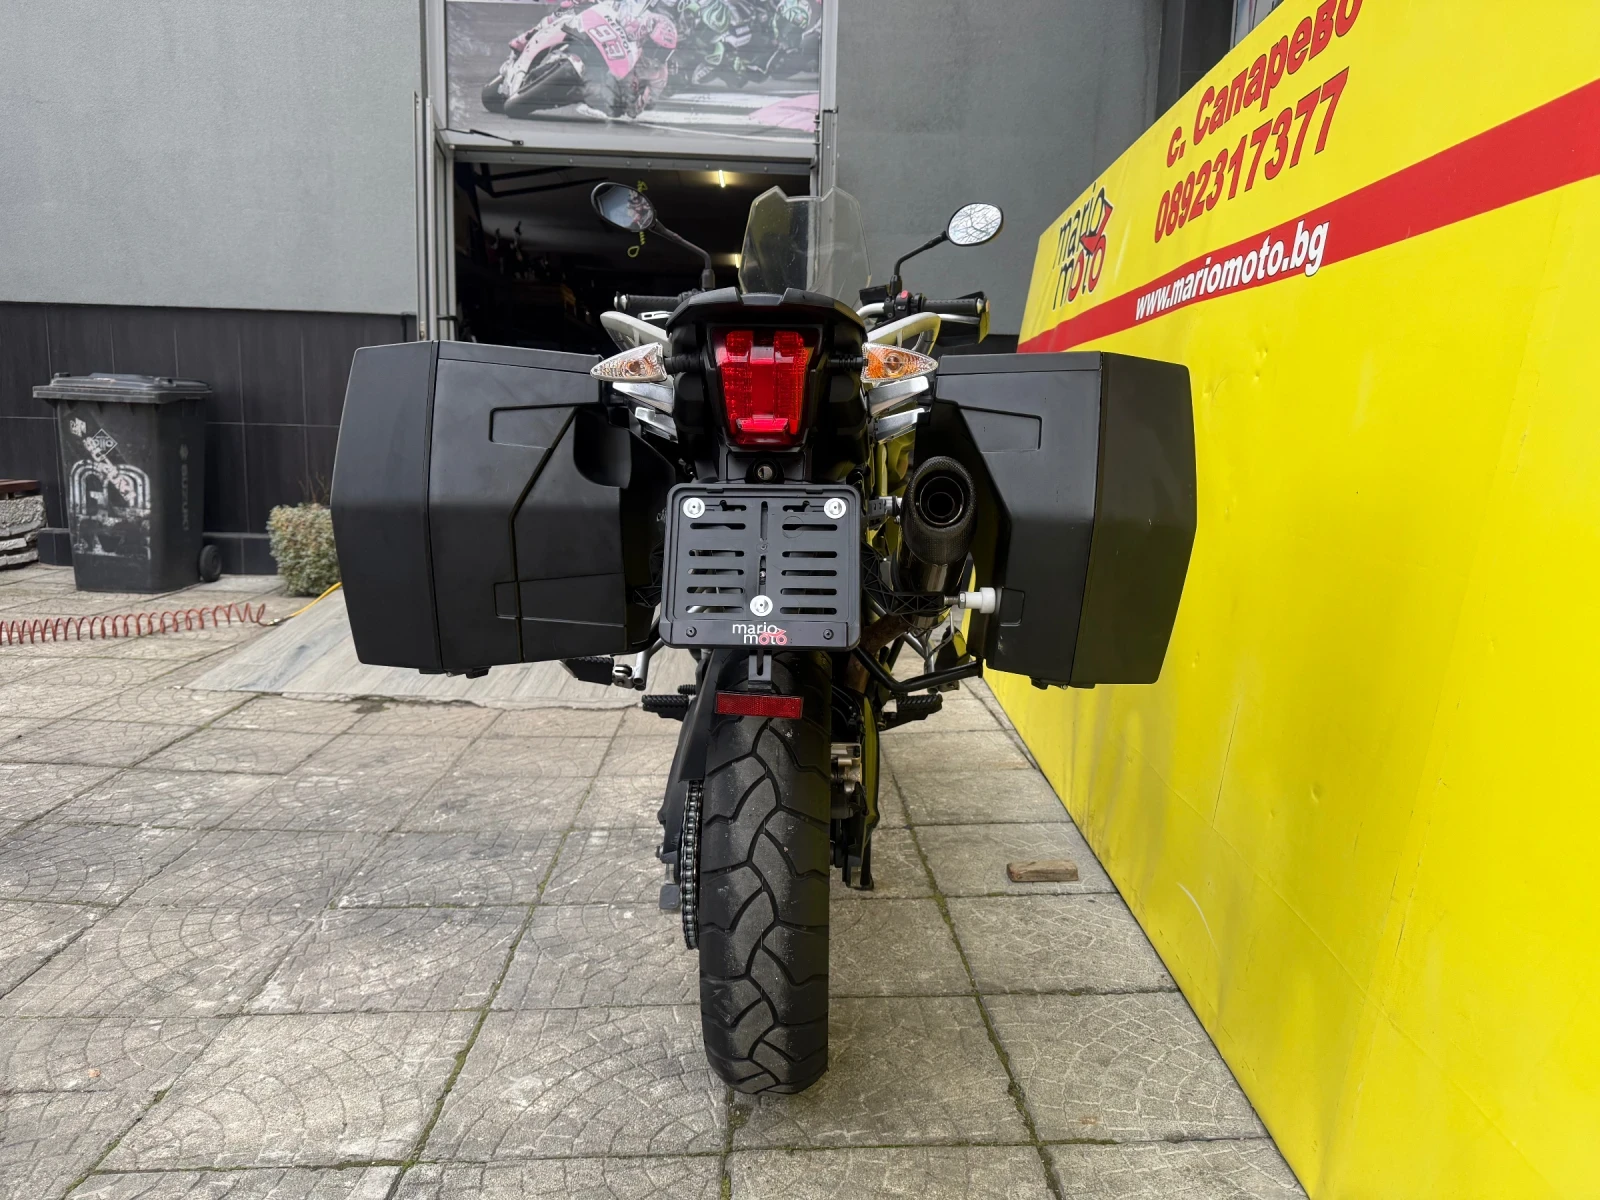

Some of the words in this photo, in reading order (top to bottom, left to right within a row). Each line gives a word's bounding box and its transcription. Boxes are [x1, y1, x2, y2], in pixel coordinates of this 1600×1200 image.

[587, 24, 627, 61] 93
[604, 15, 632, 54] REPSOL
[1192, 0, 1364, 146] Сапарево
[1154, 66, 1350, 244] 0892317377
[1052, 181, 1106, 270] mario
[1052, 234, 1107, 311] moto
[1135, 219, 1331, 321] www.mariomoto.bg
[732, 621, 778, 635] mario
[743, 633, 788, 646] moto
